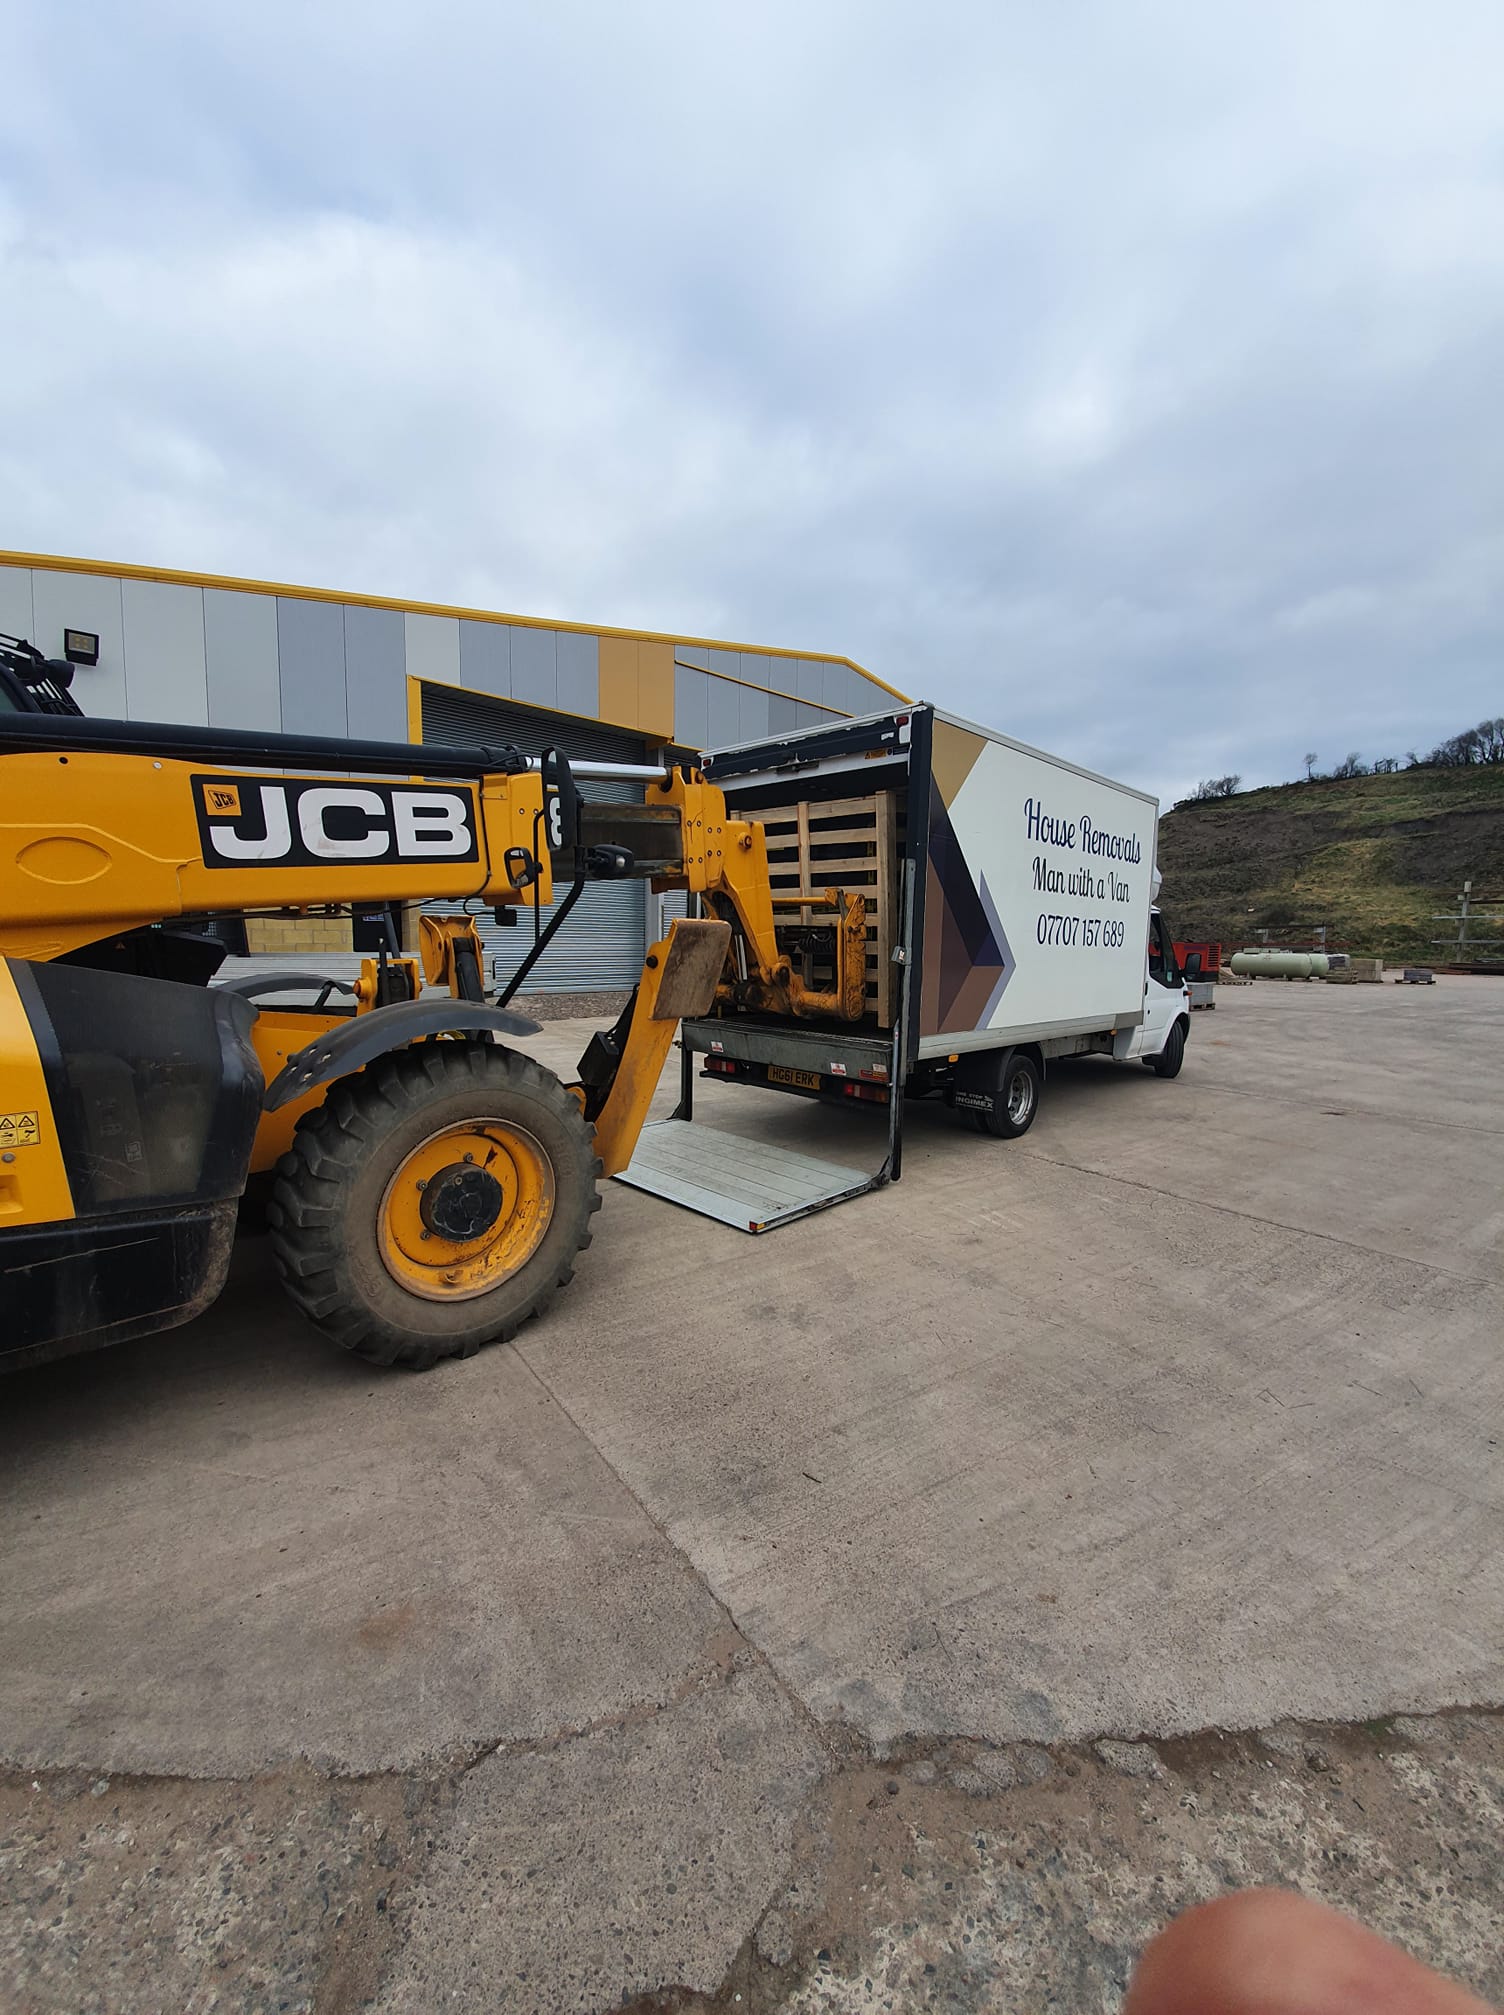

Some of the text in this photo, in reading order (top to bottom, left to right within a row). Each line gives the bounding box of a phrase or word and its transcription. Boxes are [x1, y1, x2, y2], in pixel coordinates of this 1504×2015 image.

[213, 792, 234, 807] JCB
[209, 786, 471, 859] JCB
[1024, 798, 1141, 864] House Removals
[1032, 856, 1130, 903] Man with a Van
[1037, 914, 1124, 948] 07707 157 689
[772, 1066, 814, 1086] HG61 ERK
